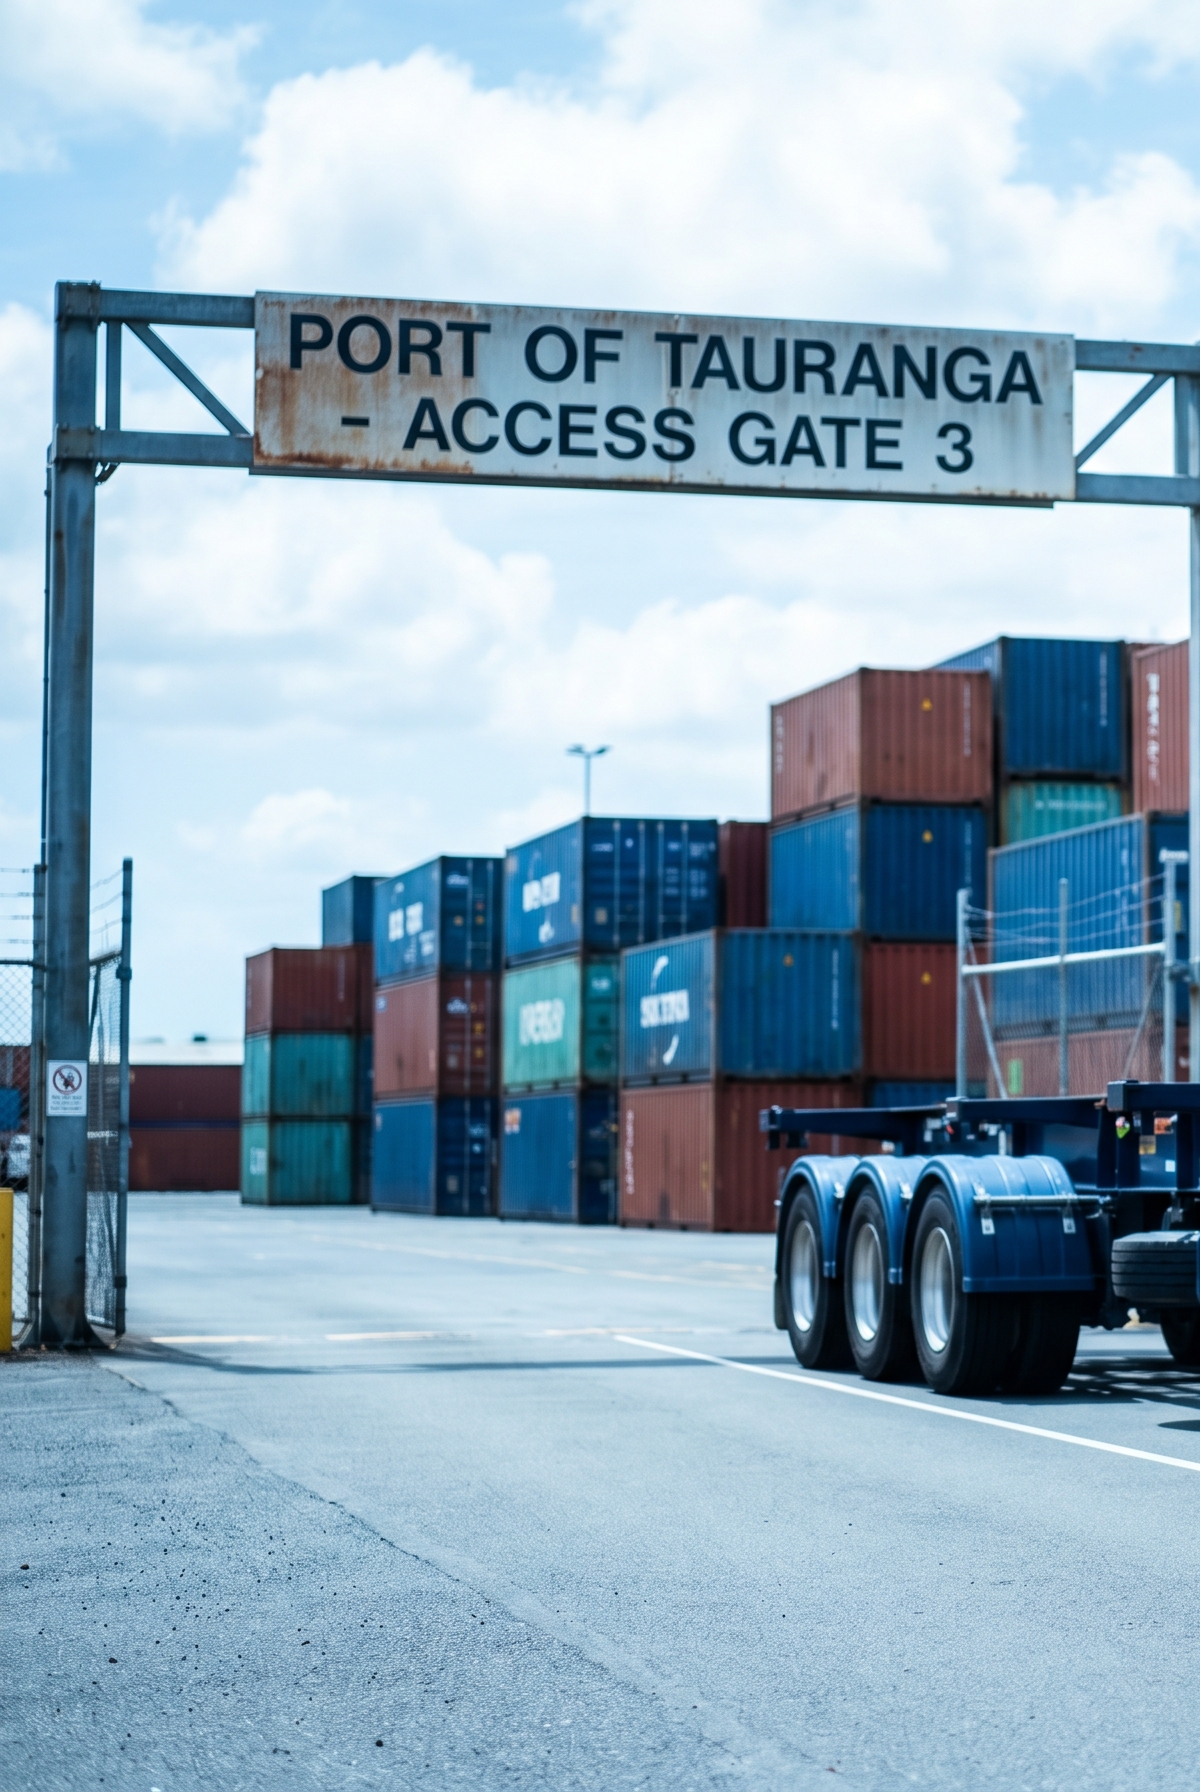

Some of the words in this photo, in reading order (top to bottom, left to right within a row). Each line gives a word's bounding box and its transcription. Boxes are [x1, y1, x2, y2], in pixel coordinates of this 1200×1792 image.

[289, 312, 491, 380] PORT
[525, 325, 624, 383] OF
[655, 331, 1043, 405] TAURANGA
[402, 397, 695, 463] ACCESS
[729, 411, 903, 470] GATE
[936, 422, 973, 473] 3
